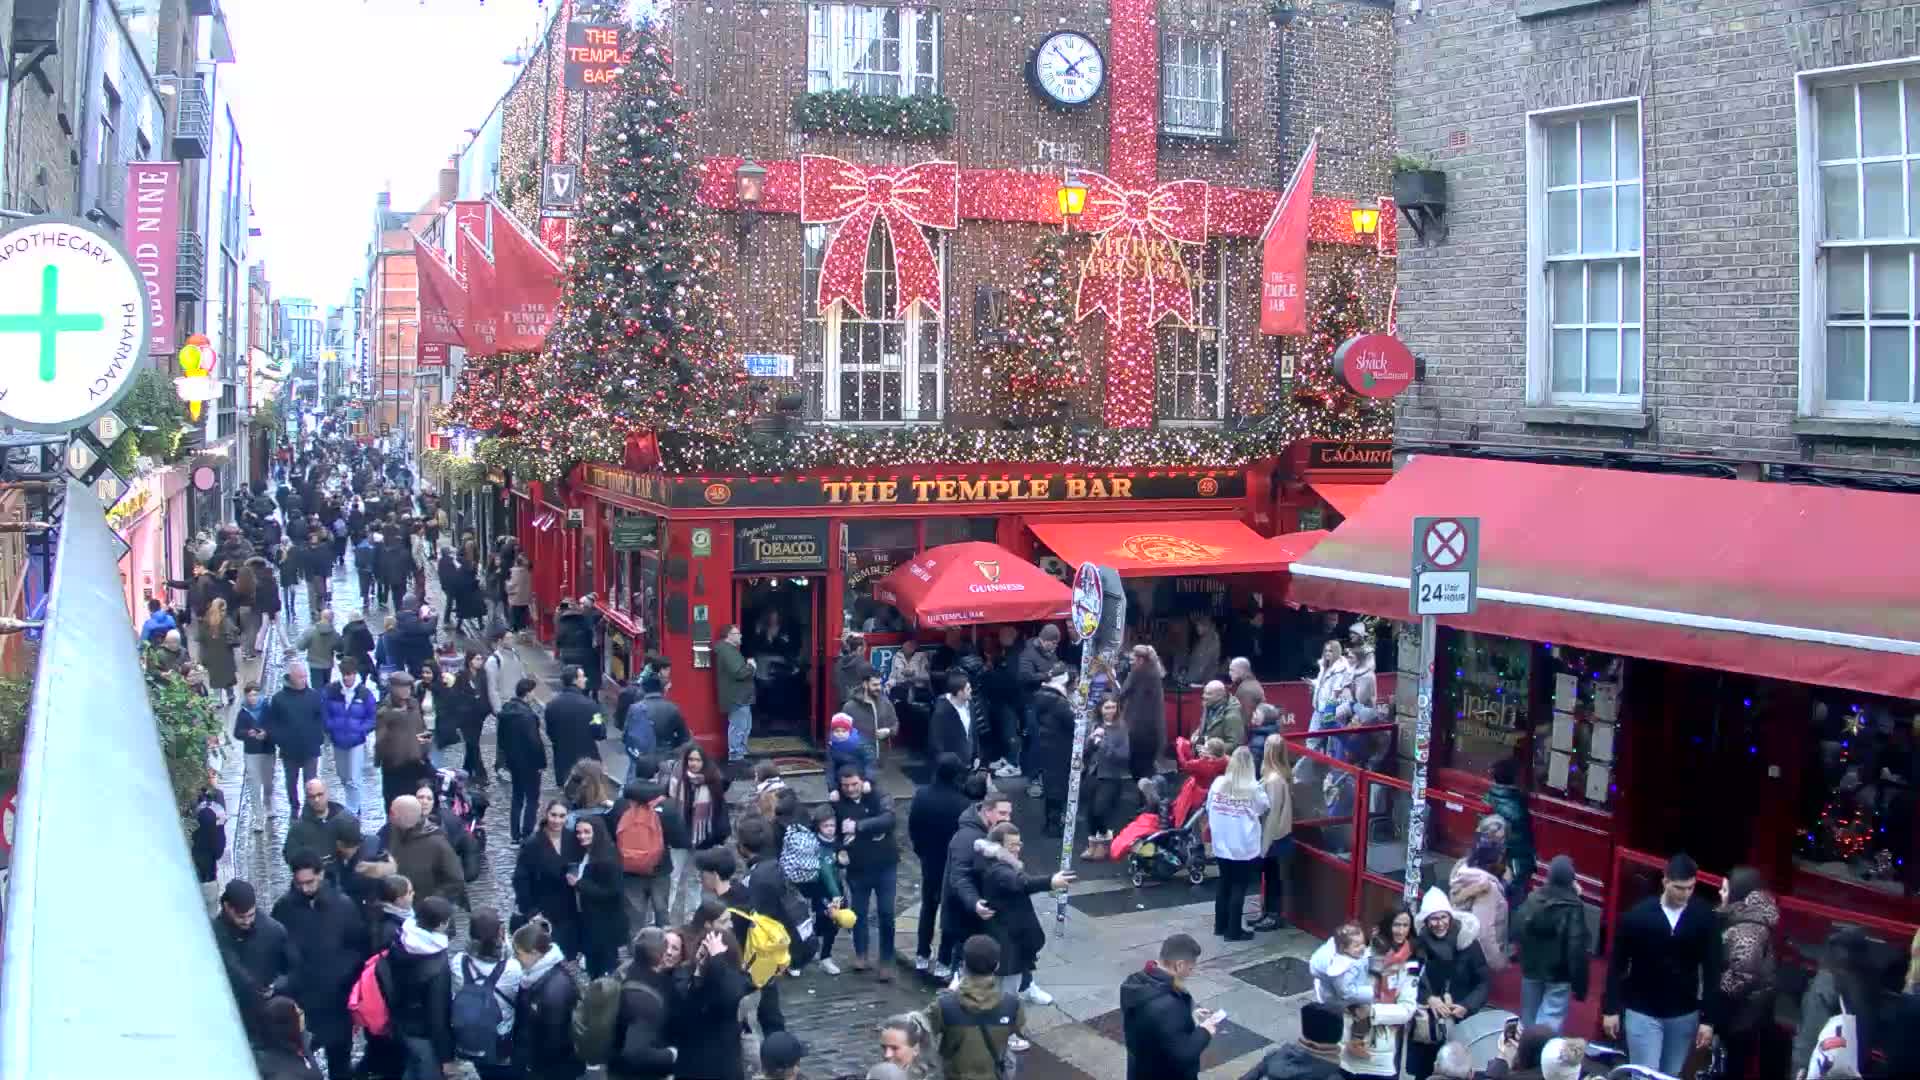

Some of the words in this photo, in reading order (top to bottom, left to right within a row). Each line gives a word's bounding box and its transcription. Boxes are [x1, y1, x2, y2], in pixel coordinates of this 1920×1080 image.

[585, 29, 618, 45] THE
[568, 47, 632, 64] TEMPLE
[138, 171, 169, 232] NINE
[88, 303, 137, 400] PHARMACY
[1356, 350, 1388, 374] Shack
[823, 481, 898, 503] THE
[913, 479, 1049, 502] TEMPLE
[1066, 477, 1133, 499] BAR
[752, 538, 816, 561] TOBACCO
[967, 583, 1025, 593] GUINNESS
[1421, 583, 1442, 602] 24
